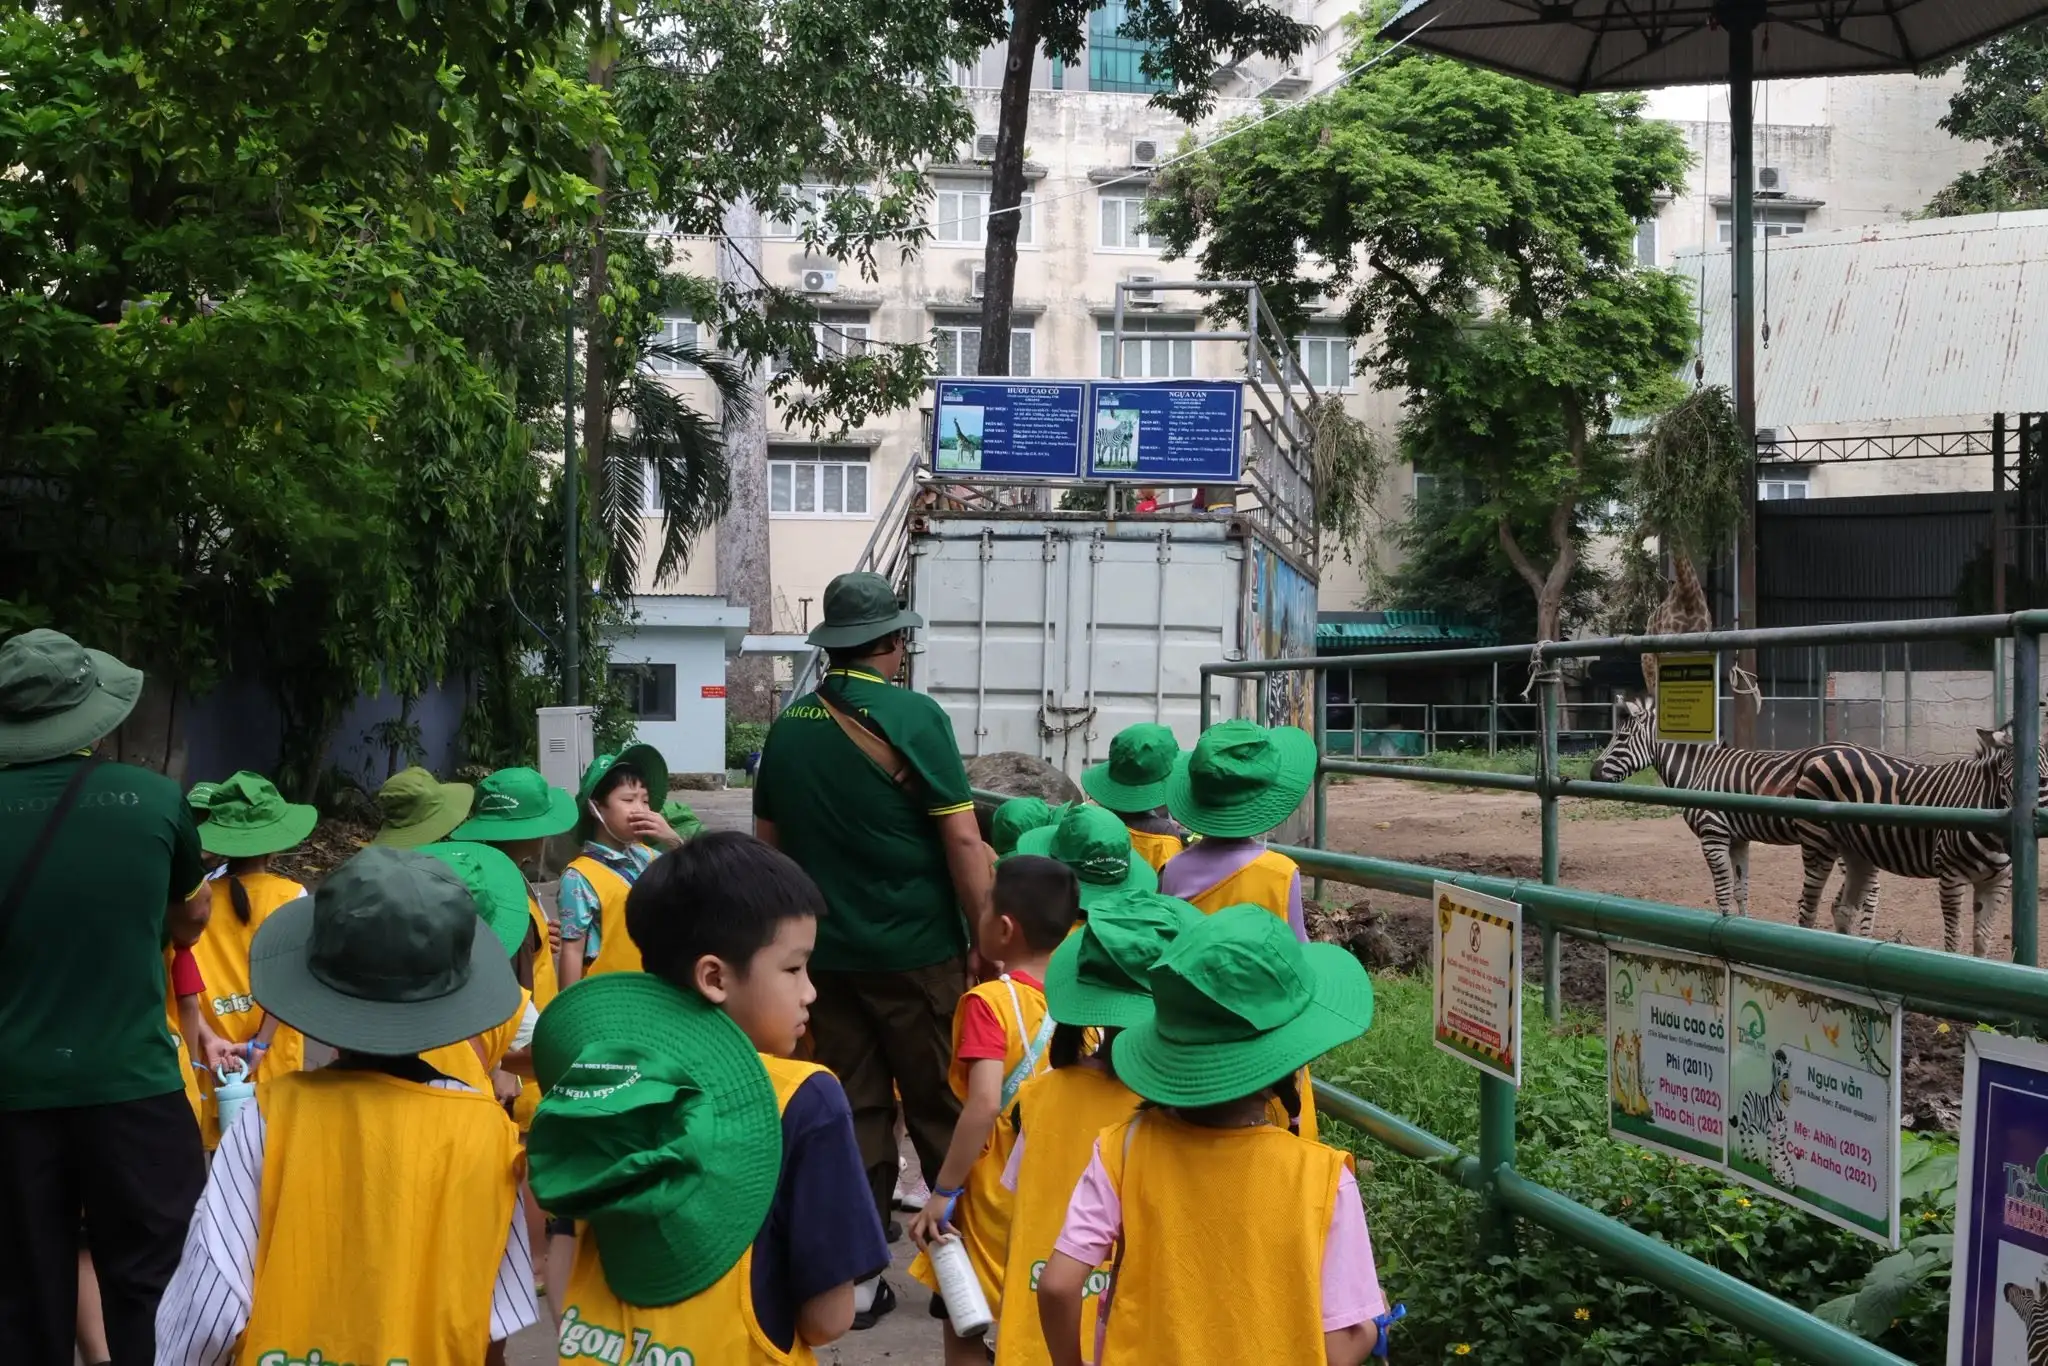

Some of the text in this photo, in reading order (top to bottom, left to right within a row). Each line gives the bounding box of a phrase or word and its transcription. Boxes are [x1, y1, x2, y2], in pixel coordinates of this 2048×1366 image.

[1031, 387, 1047, 395] CAO
[1650, 1005, 1681, 1030] Hươu
[1683, 1017, 1706, 1036] cao
[1709, 1013, 1725, 1040] cổ
[1666, 1053, 1713, 1083] Phi (2011)
[1807, 1066, 1863, 1100] Ngựa vằn
[1659, 1076, 1722, 1113] Phụng (2022)
[1793, 1120, 1872, 1166] Mẹ: Ahihi (2012)
[1810, 1151, 1842, 1176] Ahaha
[1844, 1160, 1877, 1193] (2021)
